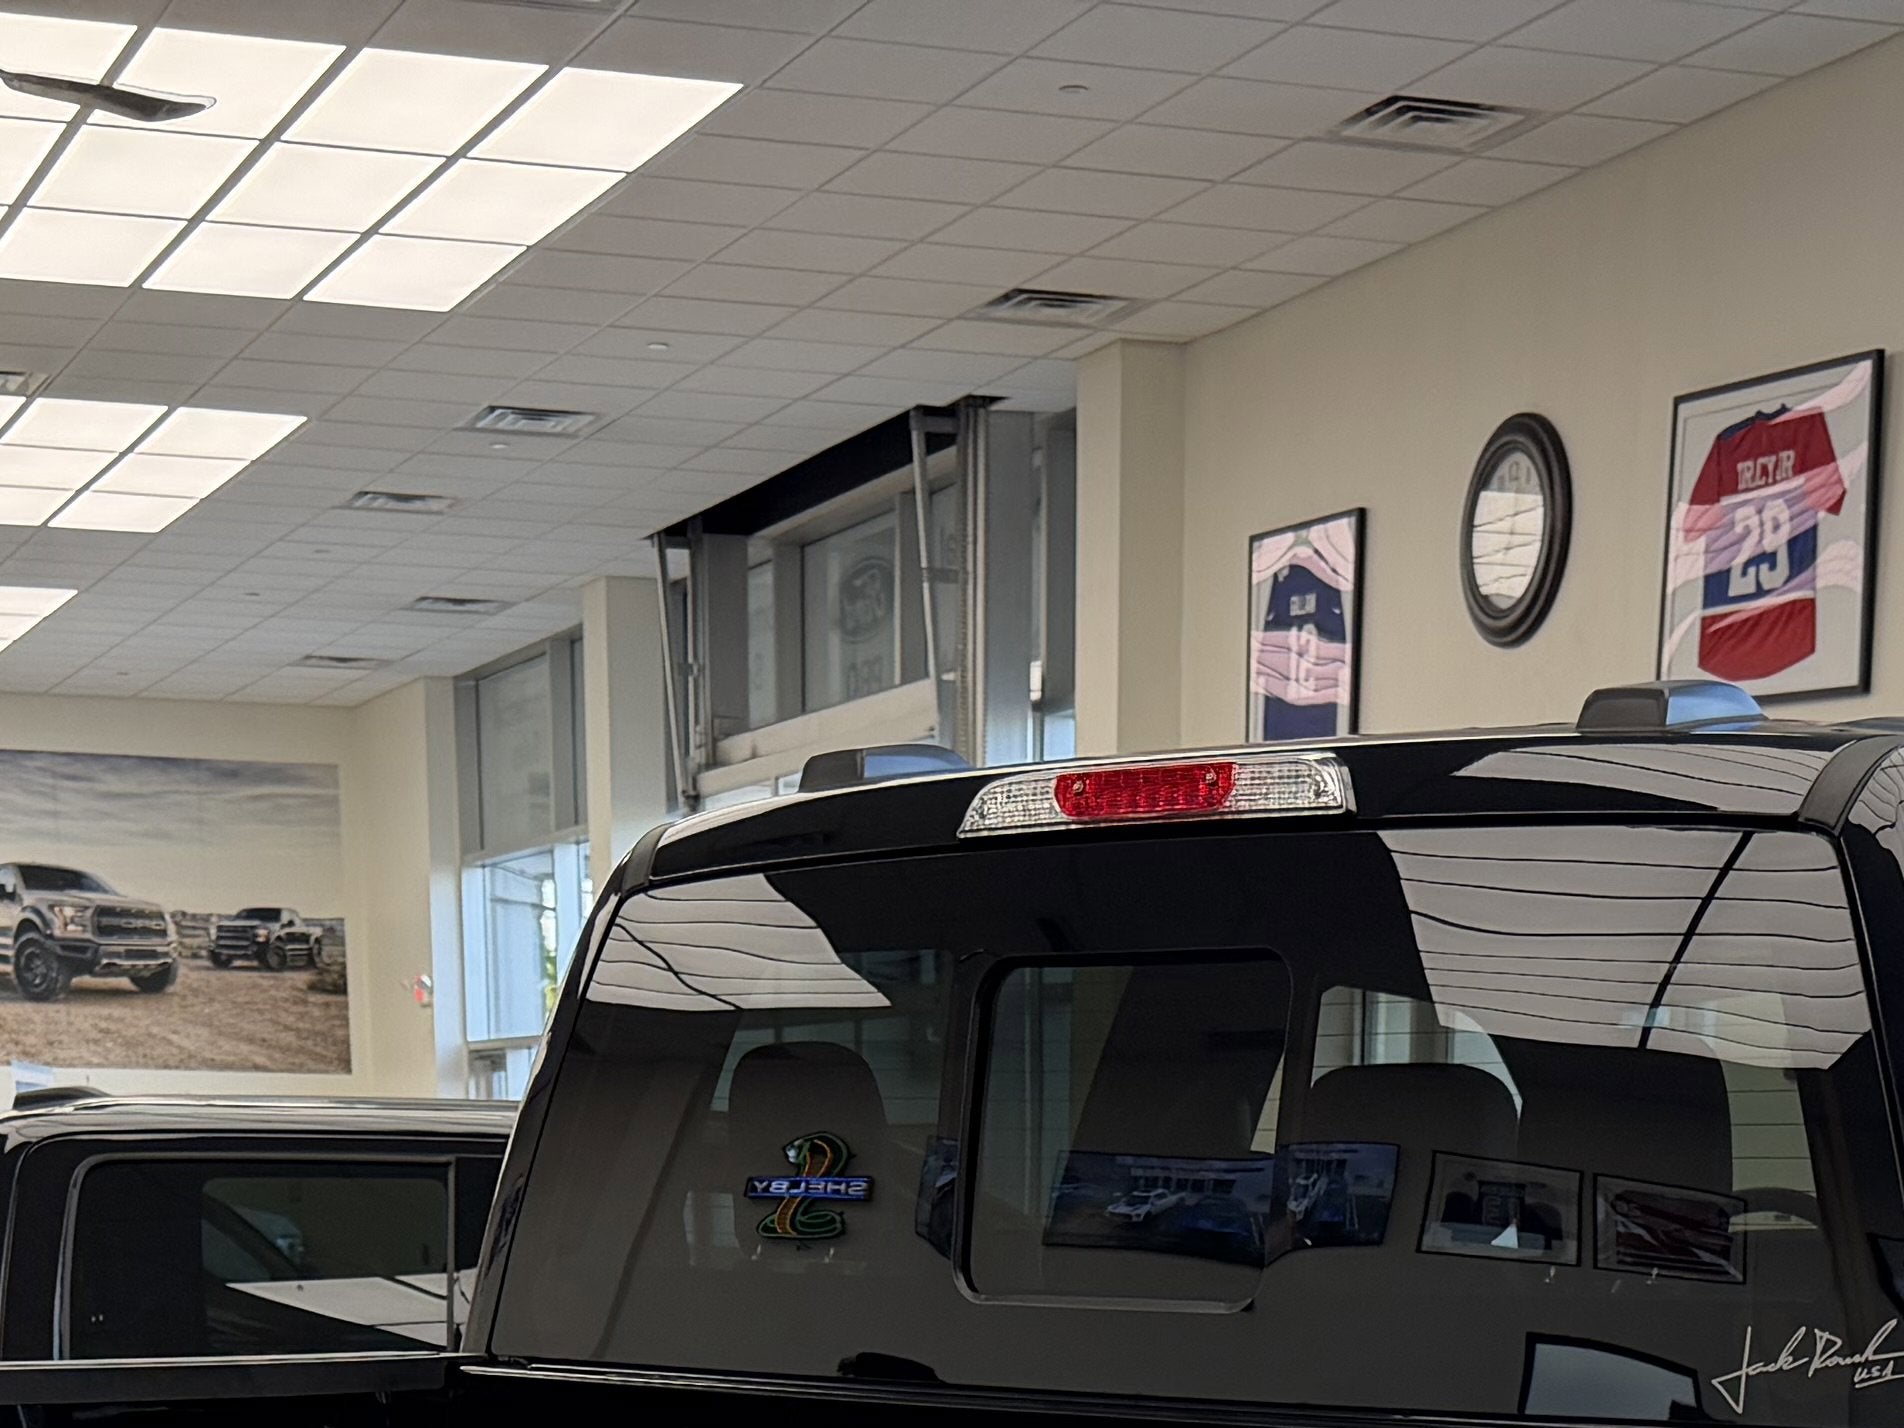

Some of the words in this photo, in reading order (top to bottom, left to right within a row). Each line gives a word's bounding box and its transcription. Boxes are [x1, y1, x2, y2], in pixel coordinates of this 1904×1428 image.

[1727, 498, 1792, 598] 29
[1711, 1325, 1809, 1415] Jack
[1853, 1360, 1896, 1383] USA
